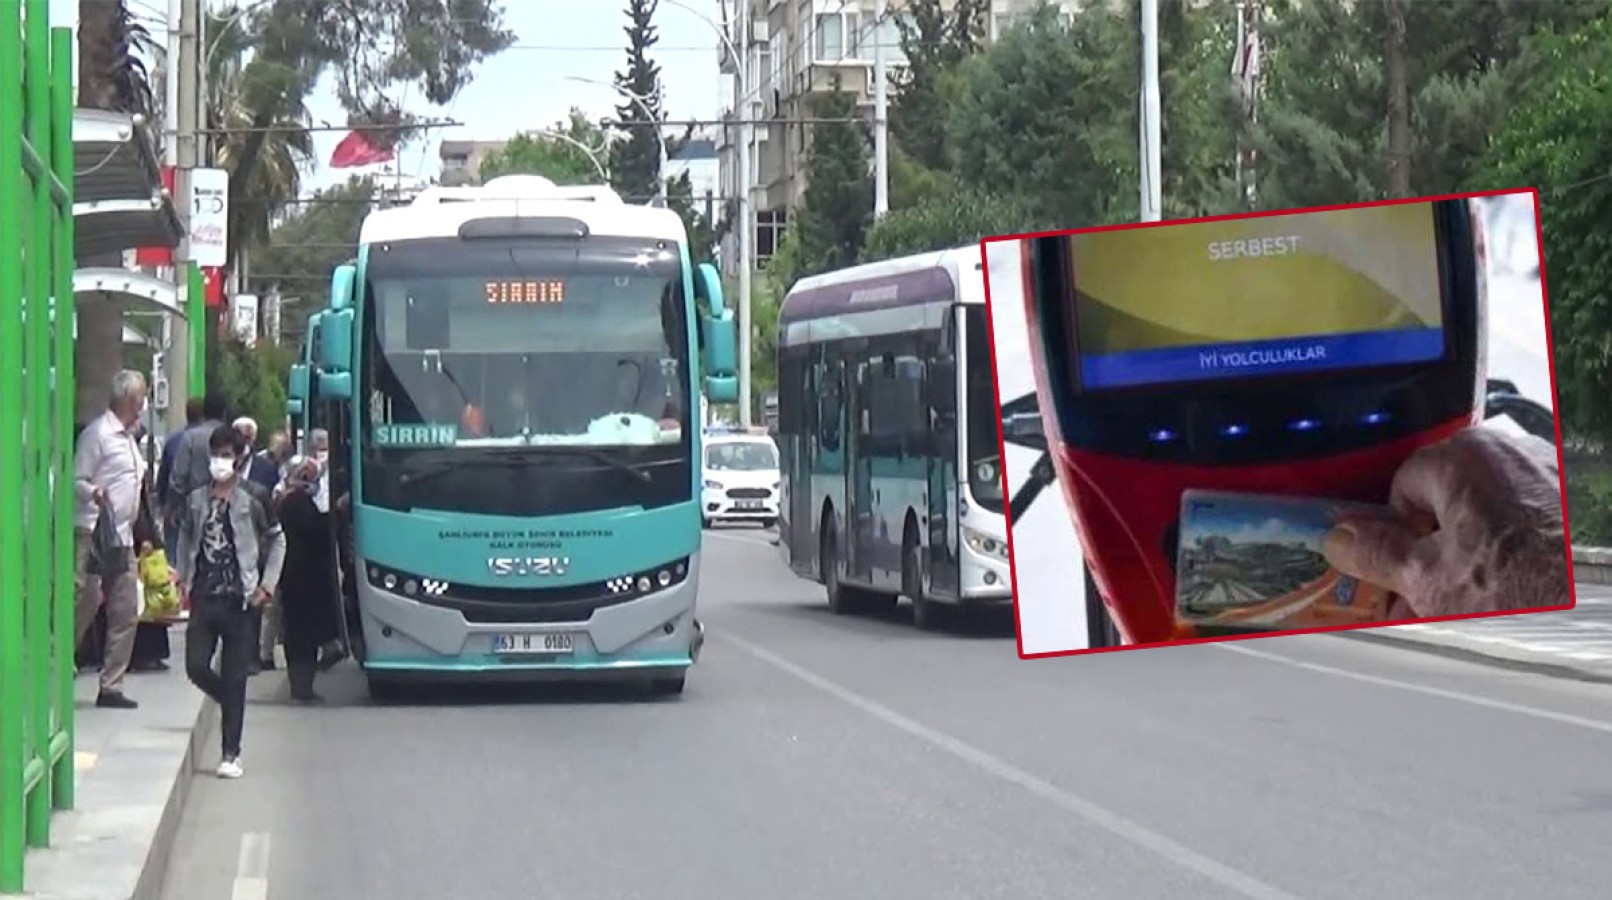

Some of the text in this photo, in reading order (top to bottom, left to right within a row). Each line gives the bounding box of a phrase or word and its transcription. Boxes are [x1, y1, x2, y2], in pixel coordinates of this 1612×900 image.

[1208, 235, 1301, 261] SERBEST
[1220, 345, 1326, 367] YOLCULUKLAR
[487, 557, 570, 575] ISUZU
[500, 634, 515, 650] 63
[523, 634, 531, 650] H
